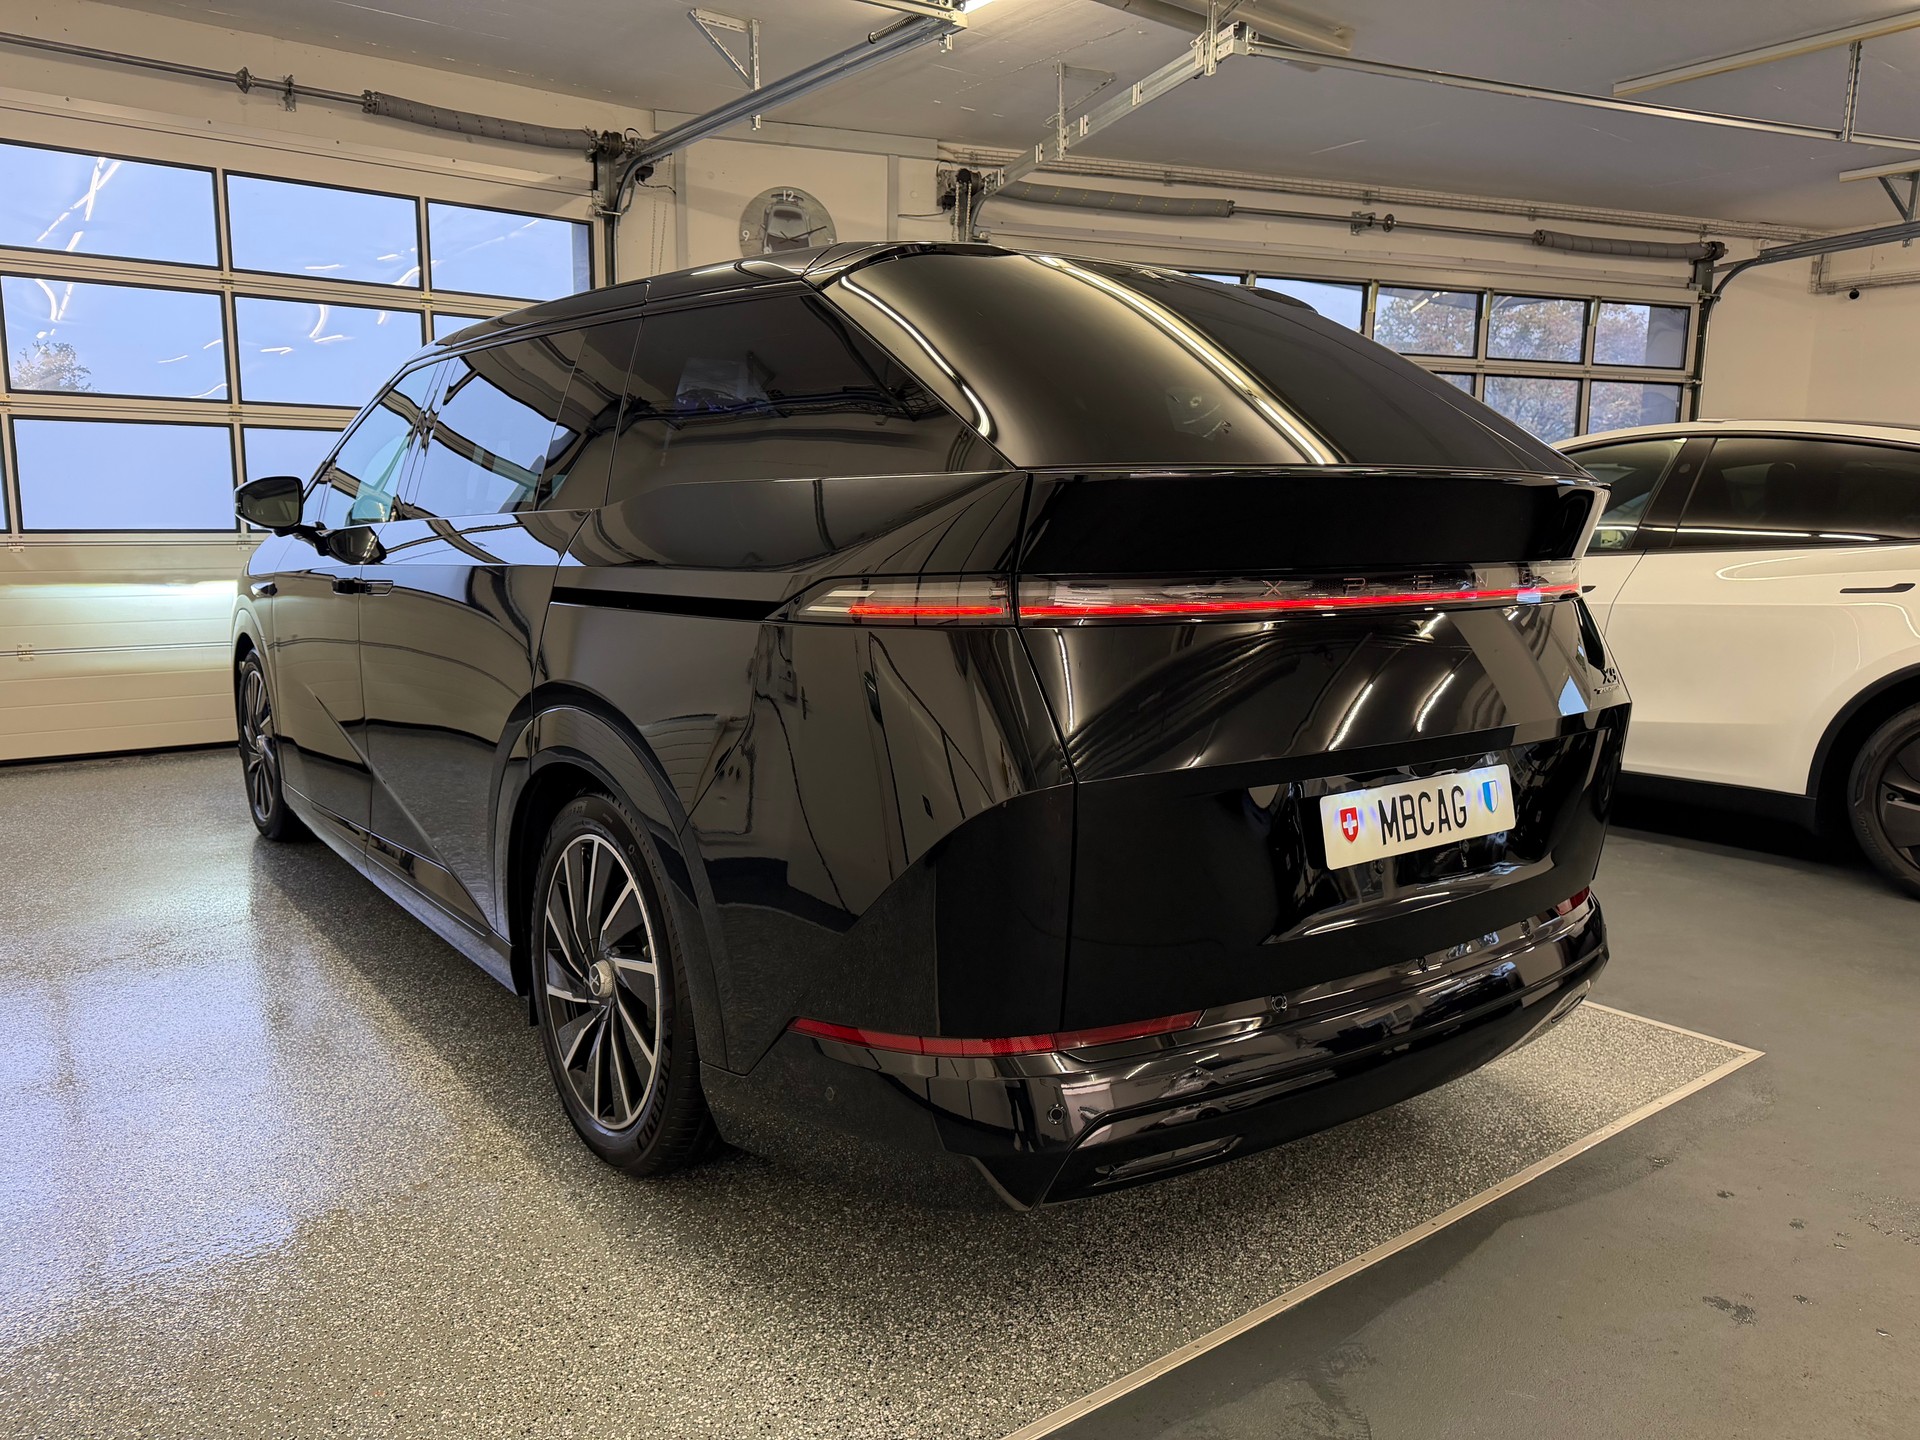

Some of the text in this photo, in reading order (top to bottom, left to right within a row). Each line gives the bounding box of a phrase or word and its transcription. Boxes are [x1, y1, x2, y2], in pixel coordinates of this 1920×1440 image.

[783, 190, 795, 201] 12
[742, 230, 750, 241] 9
[1260, 569, 1532, 597] XPENG
[1377, 785, 1467, 845] MBCAG
